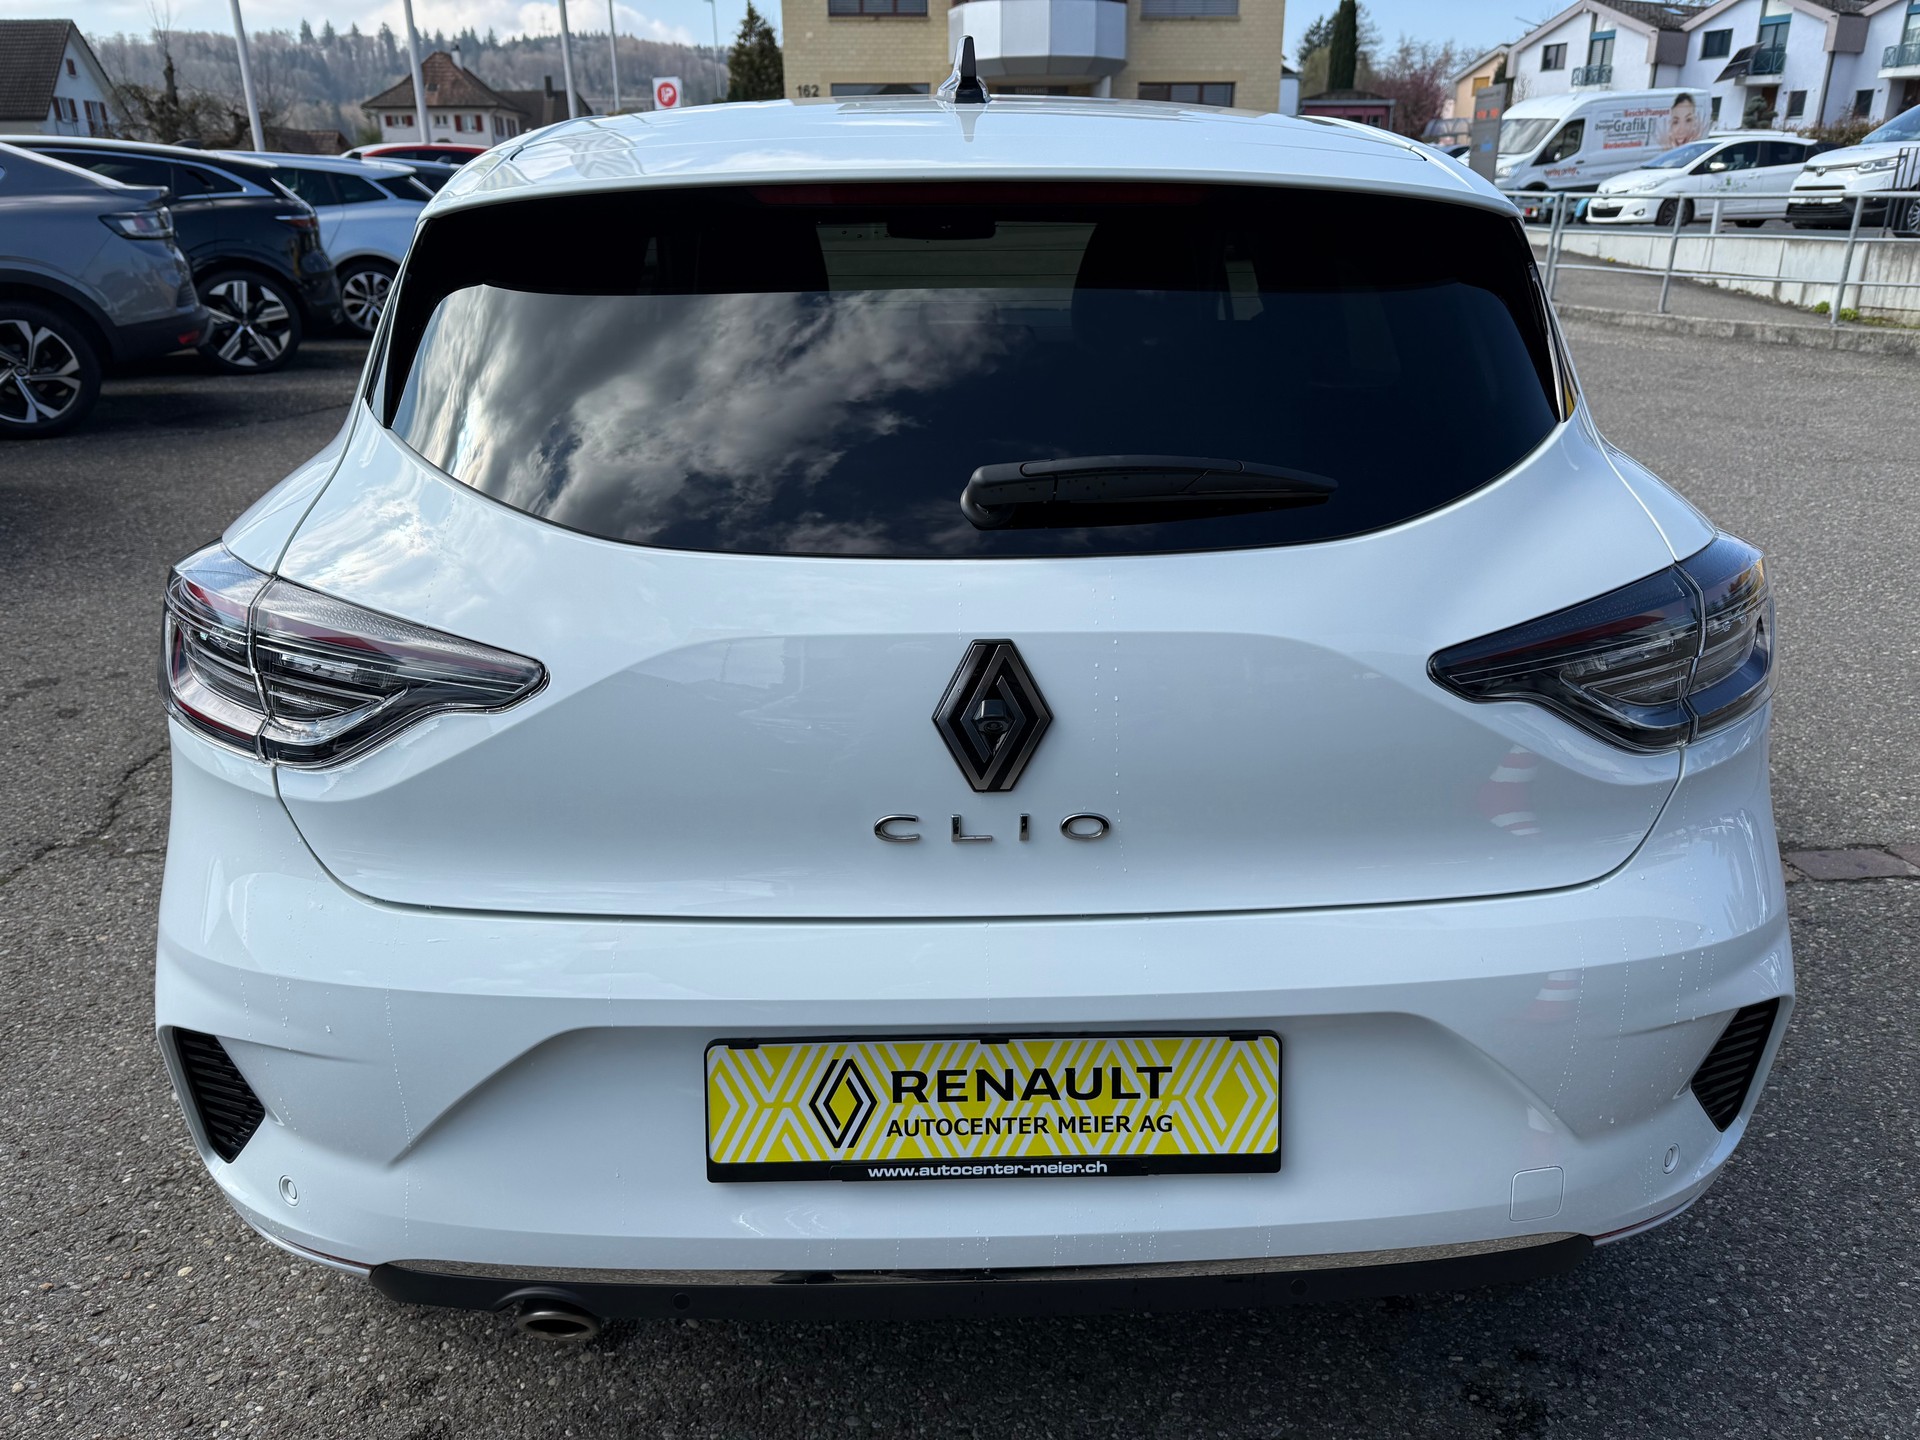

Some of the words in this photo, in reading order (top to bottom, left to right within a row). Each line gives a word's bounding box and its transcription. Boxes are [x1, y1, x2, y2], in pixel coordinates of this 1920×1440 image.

[796, 84, 820, 98] 162
[1624, 108, 1670, 118] Beschriftungen
[1613, 117, 1647, 133] Grafik
[874, 813, 1112, 843] CLIO
[890, 1066, 1173, 1104] RENAULT
[886, 1116, 1050, 1138] AUTOCENTER
[1058, 1115, 1132, 1135] MEIER
[1140, 1114, 1174, 1134] AG
[867, 1160, 1108, 1178] www.autocenter-meier.ch
